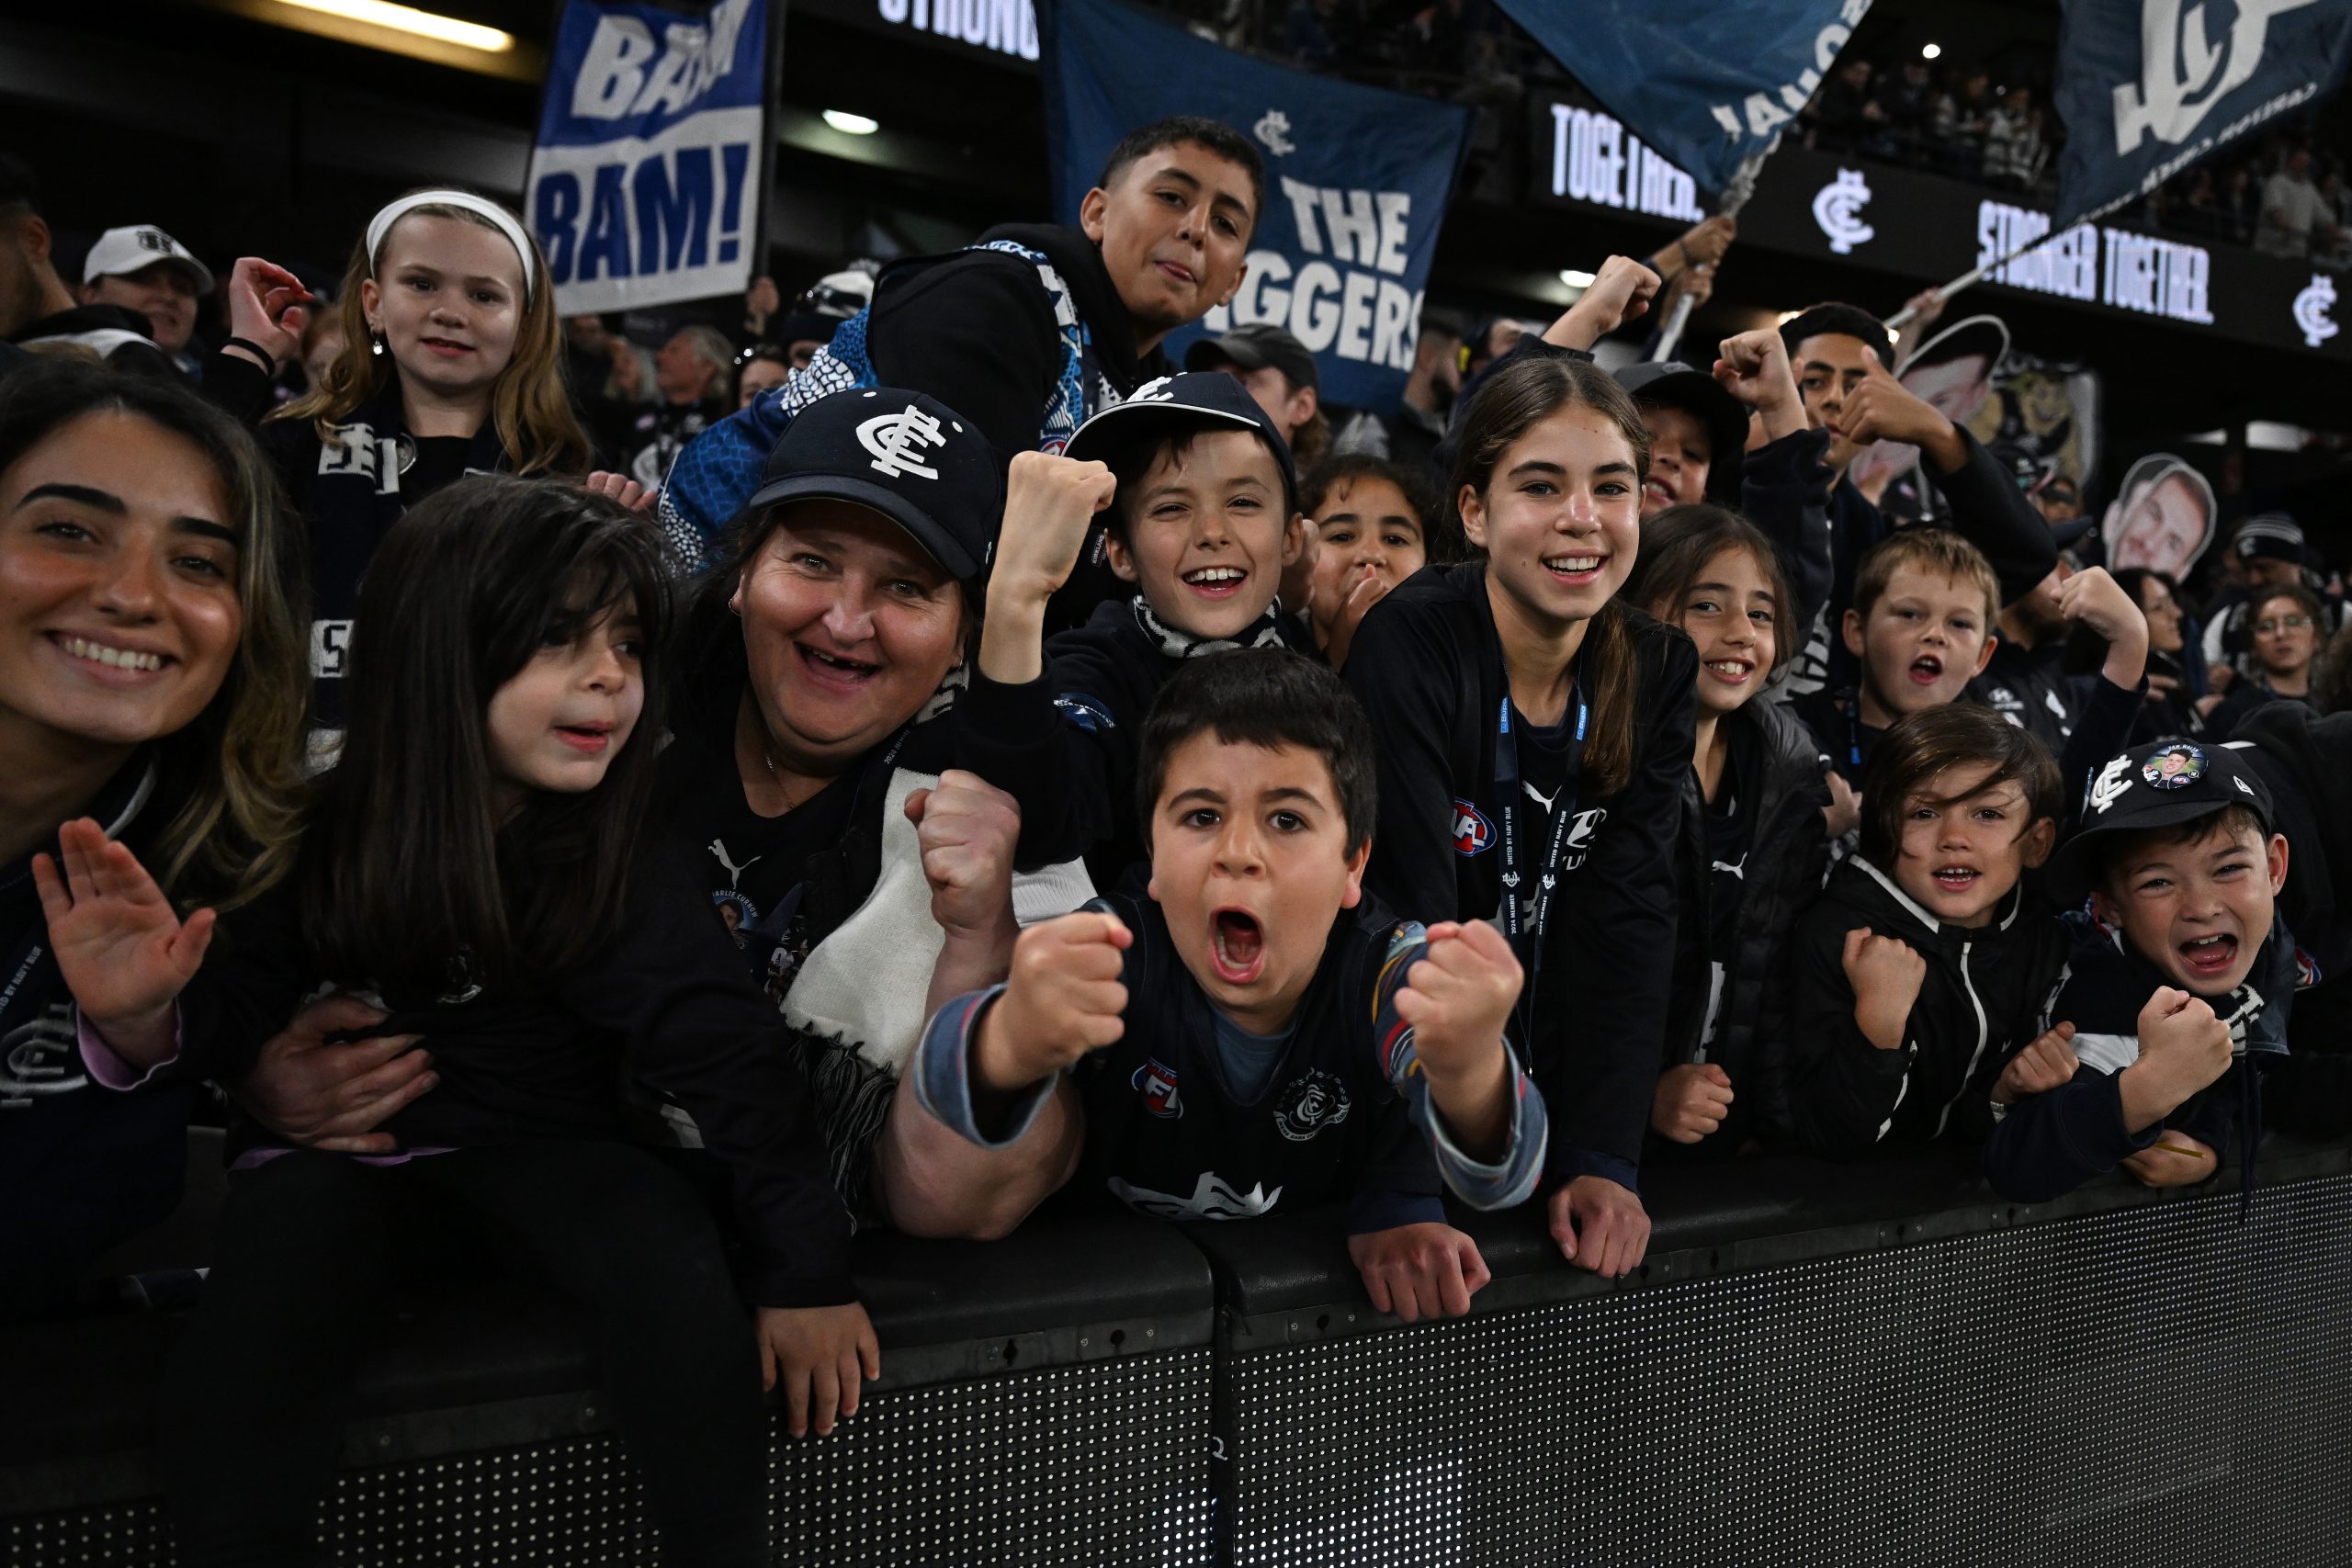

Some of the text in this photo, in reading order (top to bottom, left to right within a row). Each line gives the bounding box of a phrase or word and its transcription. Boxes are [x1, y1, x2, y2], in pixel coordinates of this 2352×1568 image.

[536, 143, 750, 287] BAM!
[1280, 175, 1411, 276] THE
[1559, 810, 1567, 823] BLUE
[1507, 837, 1513, 845] BY
[1555, 824, 1564, 840] NAVY
[1549, 849, 1558, 868] UNITED
[11, 964, 31, 986] NAVY
[25, 945, 43, 965] BLUE
